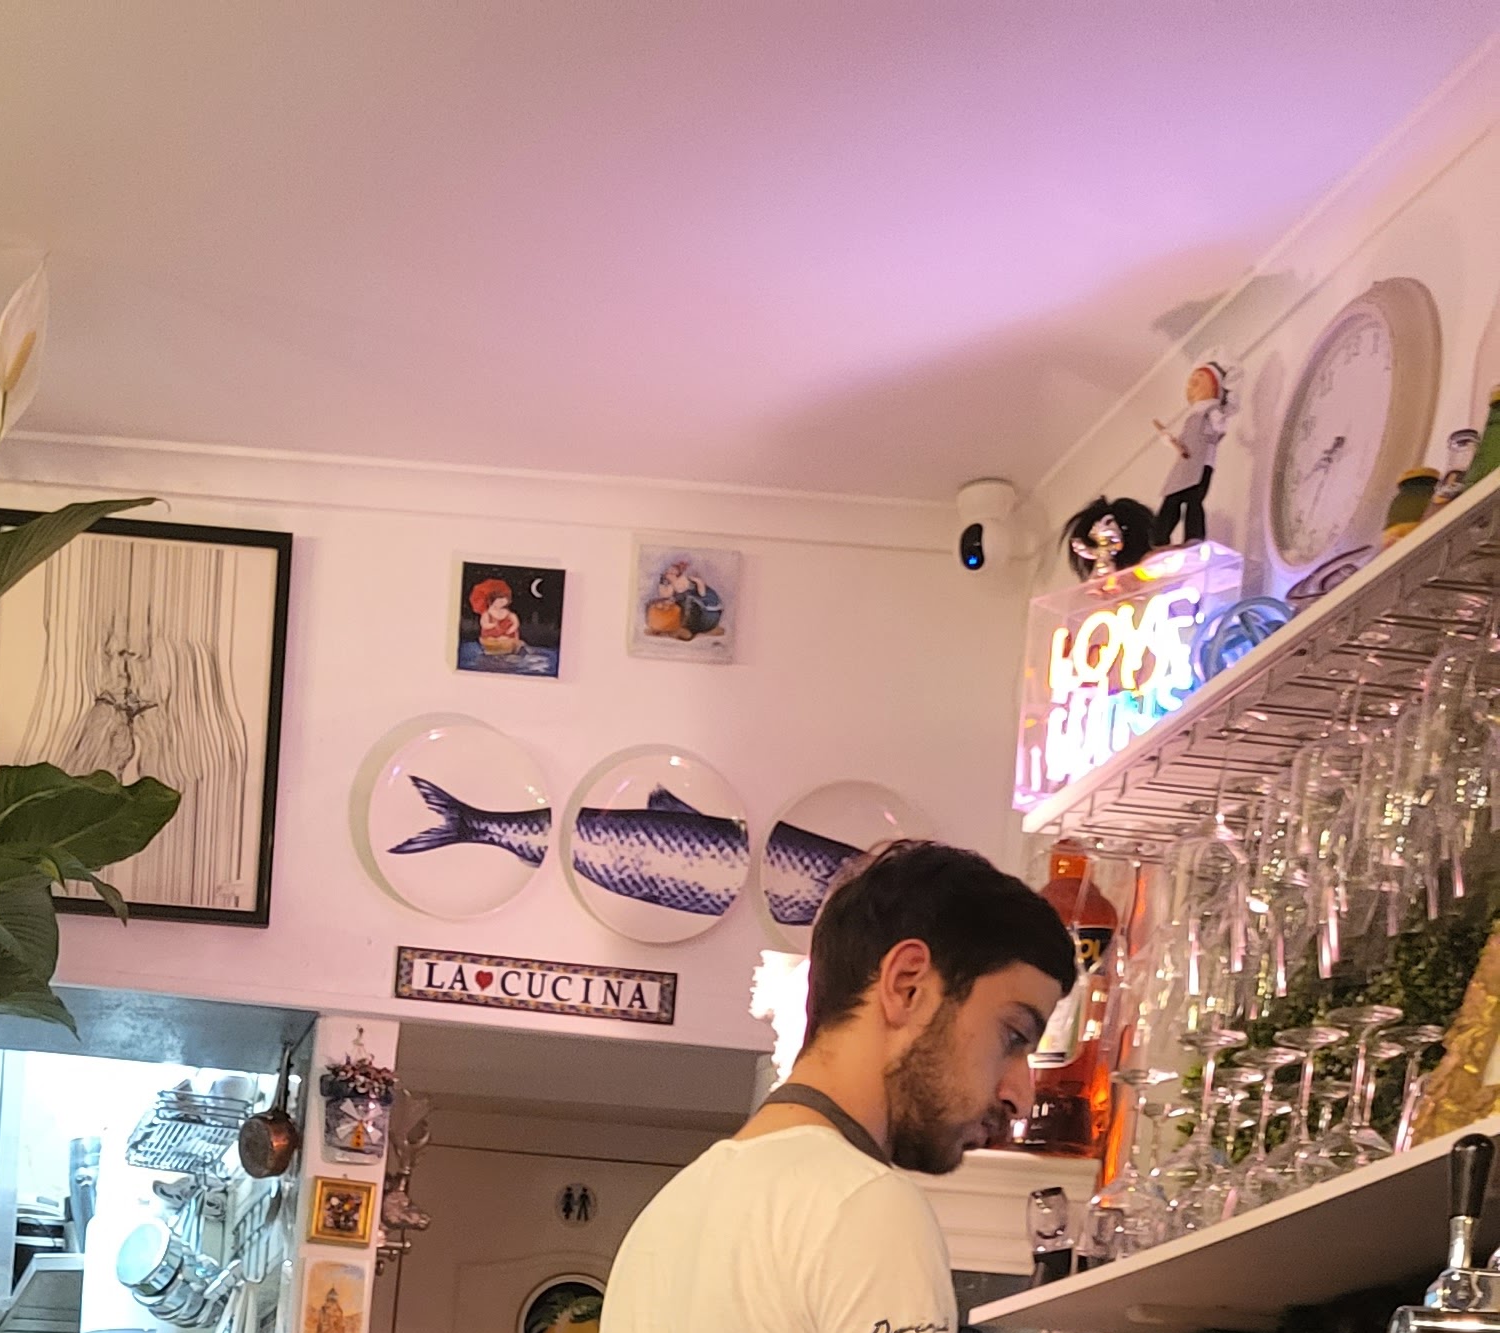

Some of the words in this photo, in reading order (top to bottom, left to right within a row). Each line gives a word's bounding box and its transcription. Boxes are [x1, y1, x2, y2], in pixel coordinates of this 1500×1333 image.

[1050, 587, 1201, 692] LOVE
[425, 961, 470, 992] LA
[499, 969, 649, 1010] CUCINA
